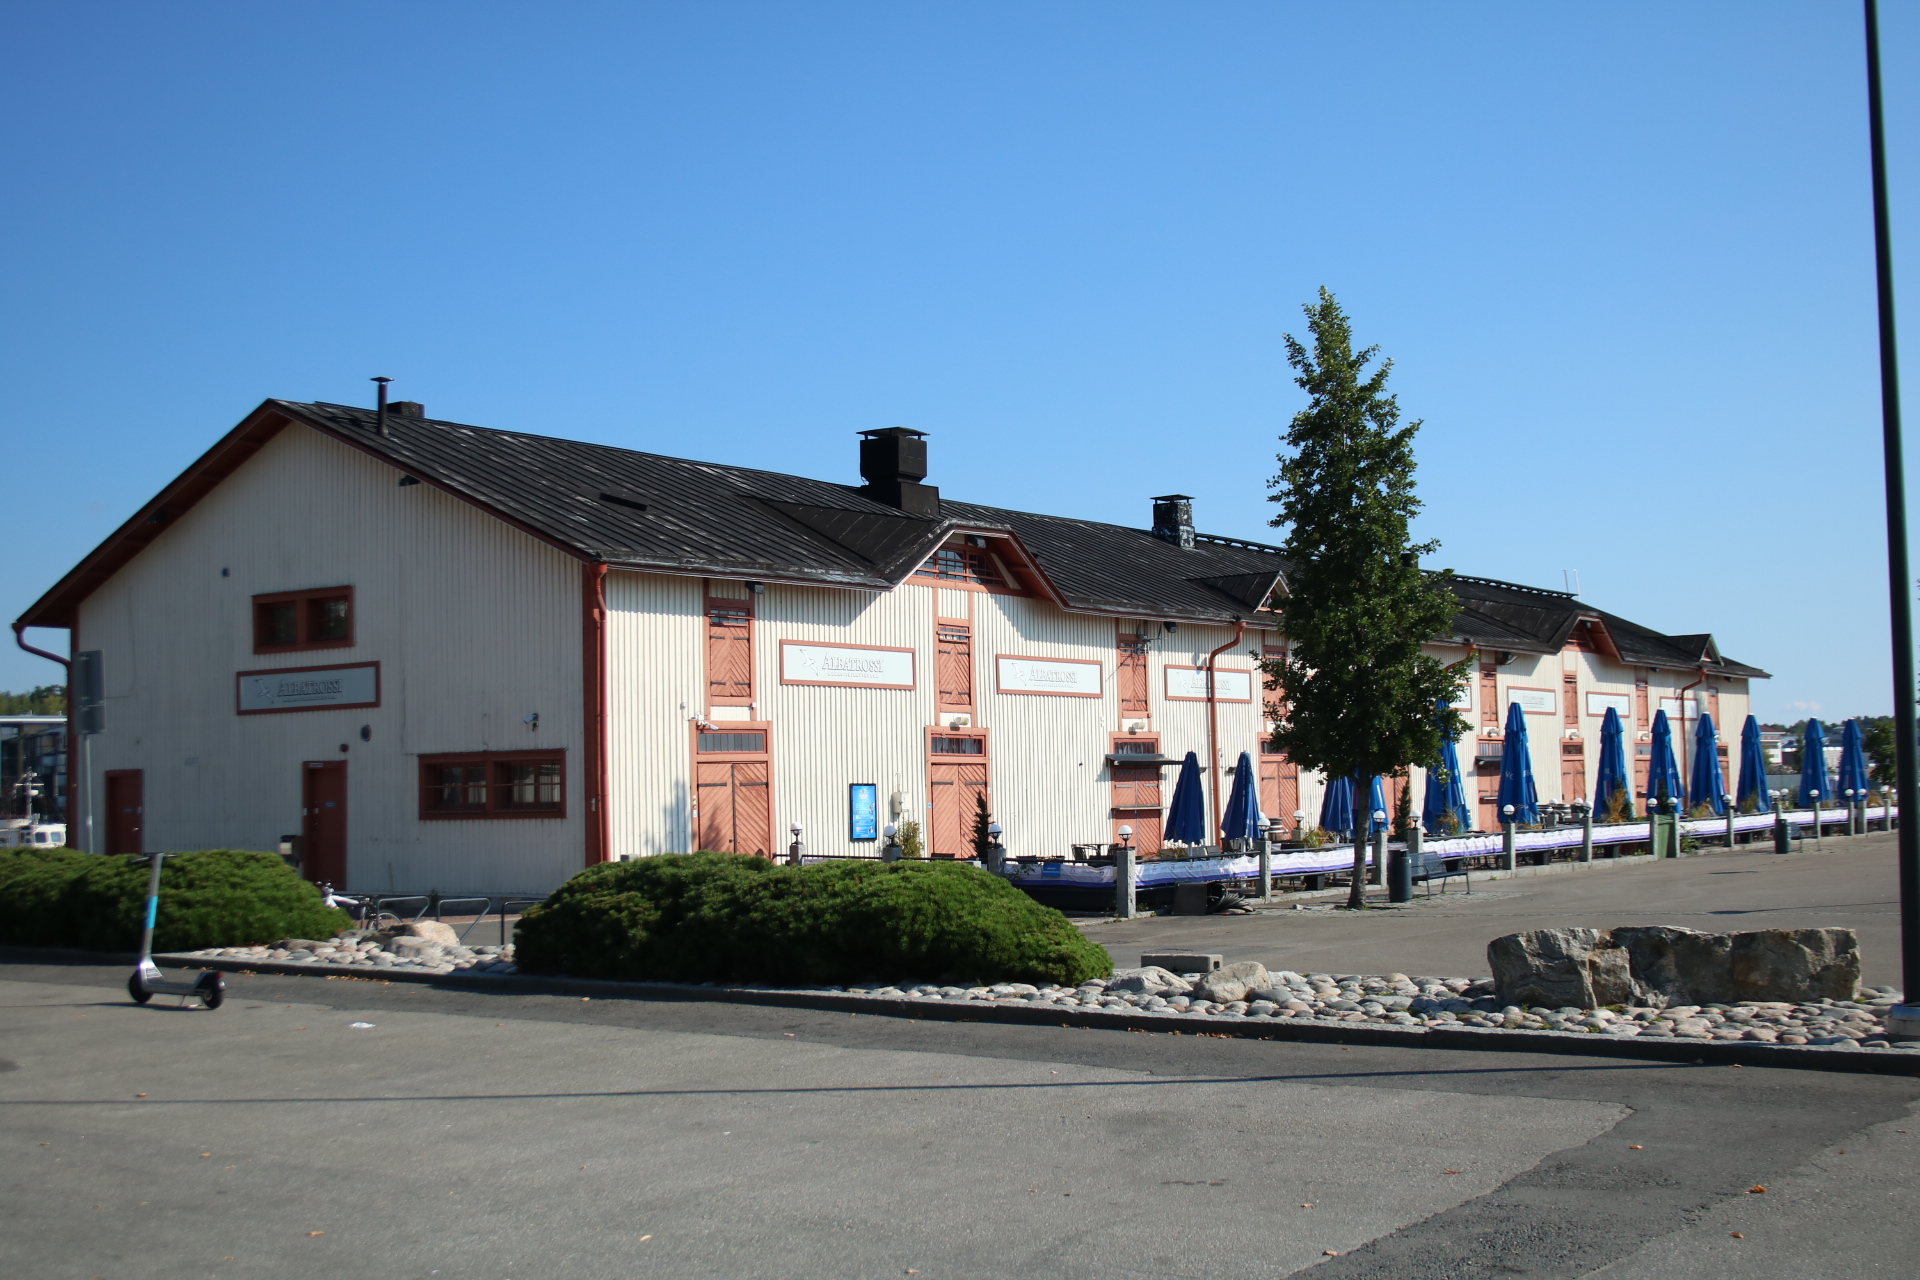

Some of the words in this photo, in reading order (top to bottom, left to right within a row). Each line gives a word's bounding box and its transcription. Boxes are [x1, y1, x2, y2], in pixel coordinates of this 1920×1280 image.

[821, 651, 884, 673] ALBATROSSI
[1029, 665, 1078, 684] ALBATROSSI
[277, 678, 343, 697] ALBATROSSI
